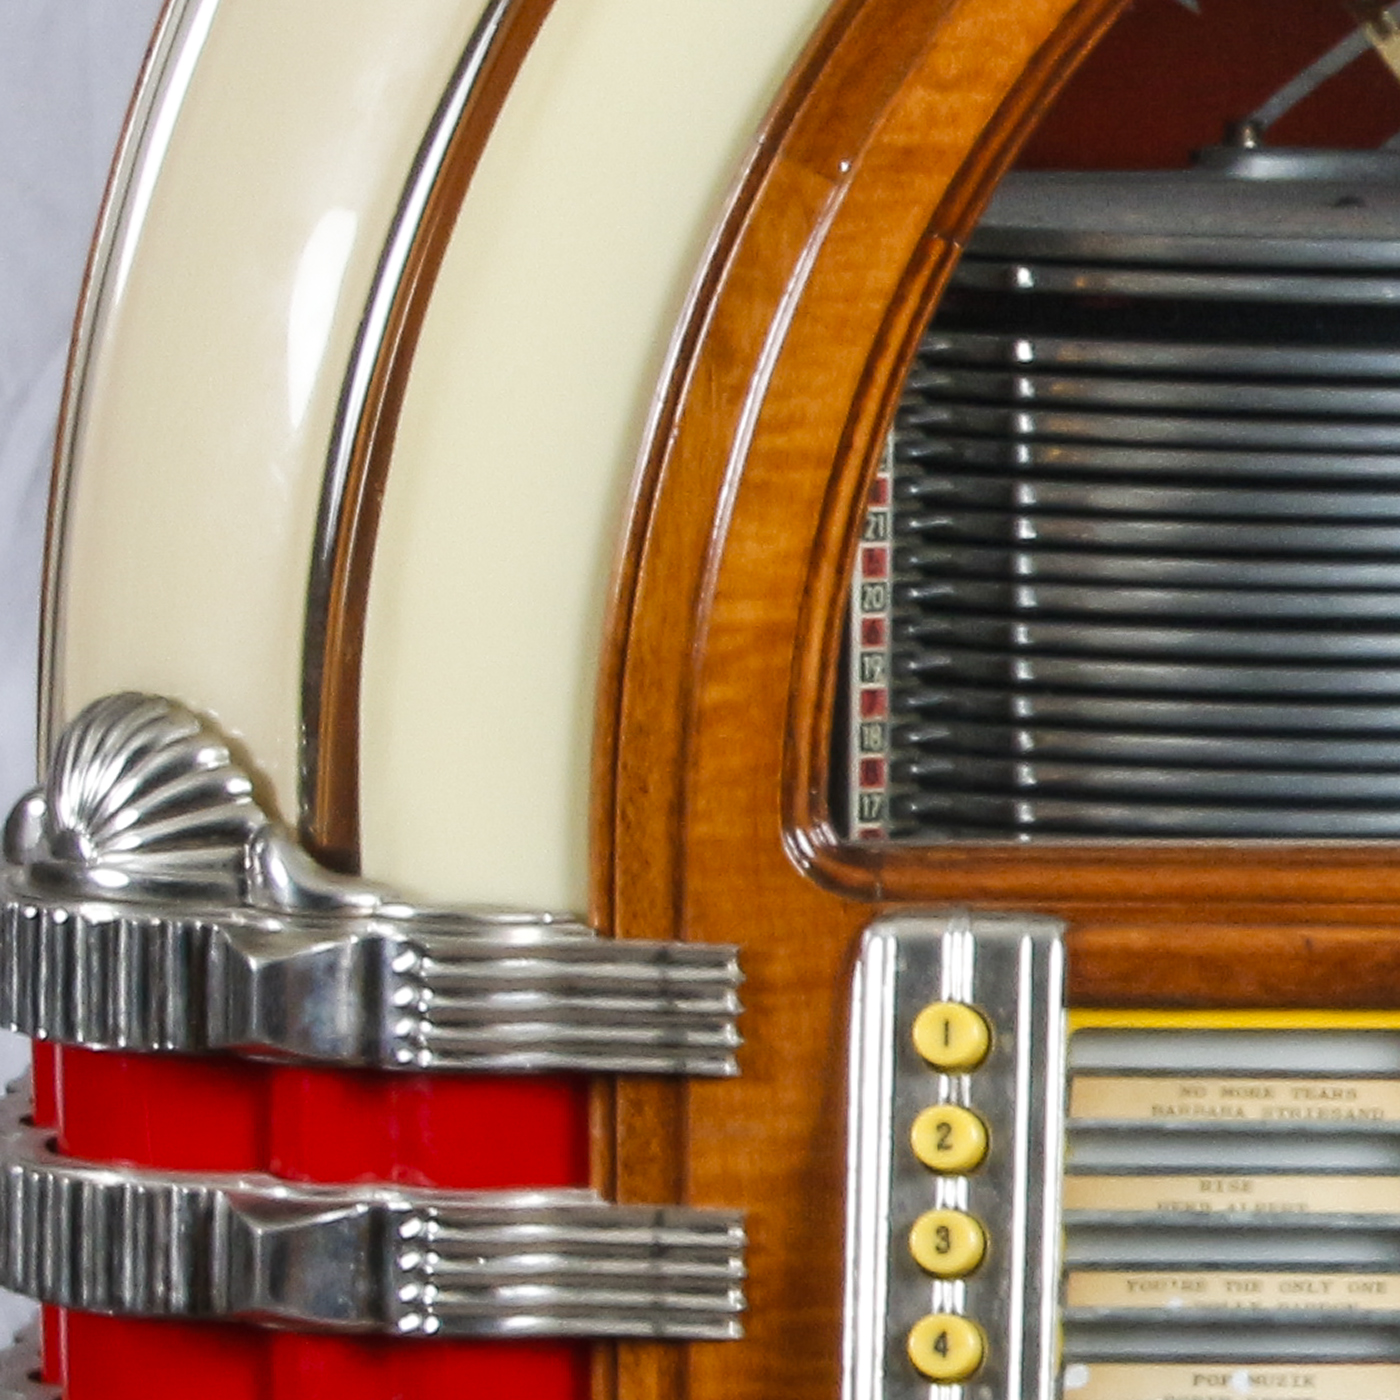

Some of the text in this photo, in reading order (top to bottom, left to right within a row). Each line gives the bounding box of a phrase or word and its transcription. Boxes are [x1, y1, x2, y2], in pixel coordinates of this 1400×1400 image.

[942, 1020, 951, 1046] 1
[1291, 1088, 1358, 1100] TEARS
[936, 1122, 953, 1151] 2
[1199, 1181, 1253, 1192] RISE
[934, 1224, 951, 1254] 3
[1224, 1282, 1260, 1293] THE
[1279, 1282, 1333, 1294] ONLY
[1349, 1282, 1387, 1294] ONE
[933, 1330, 950, 1358] 4
